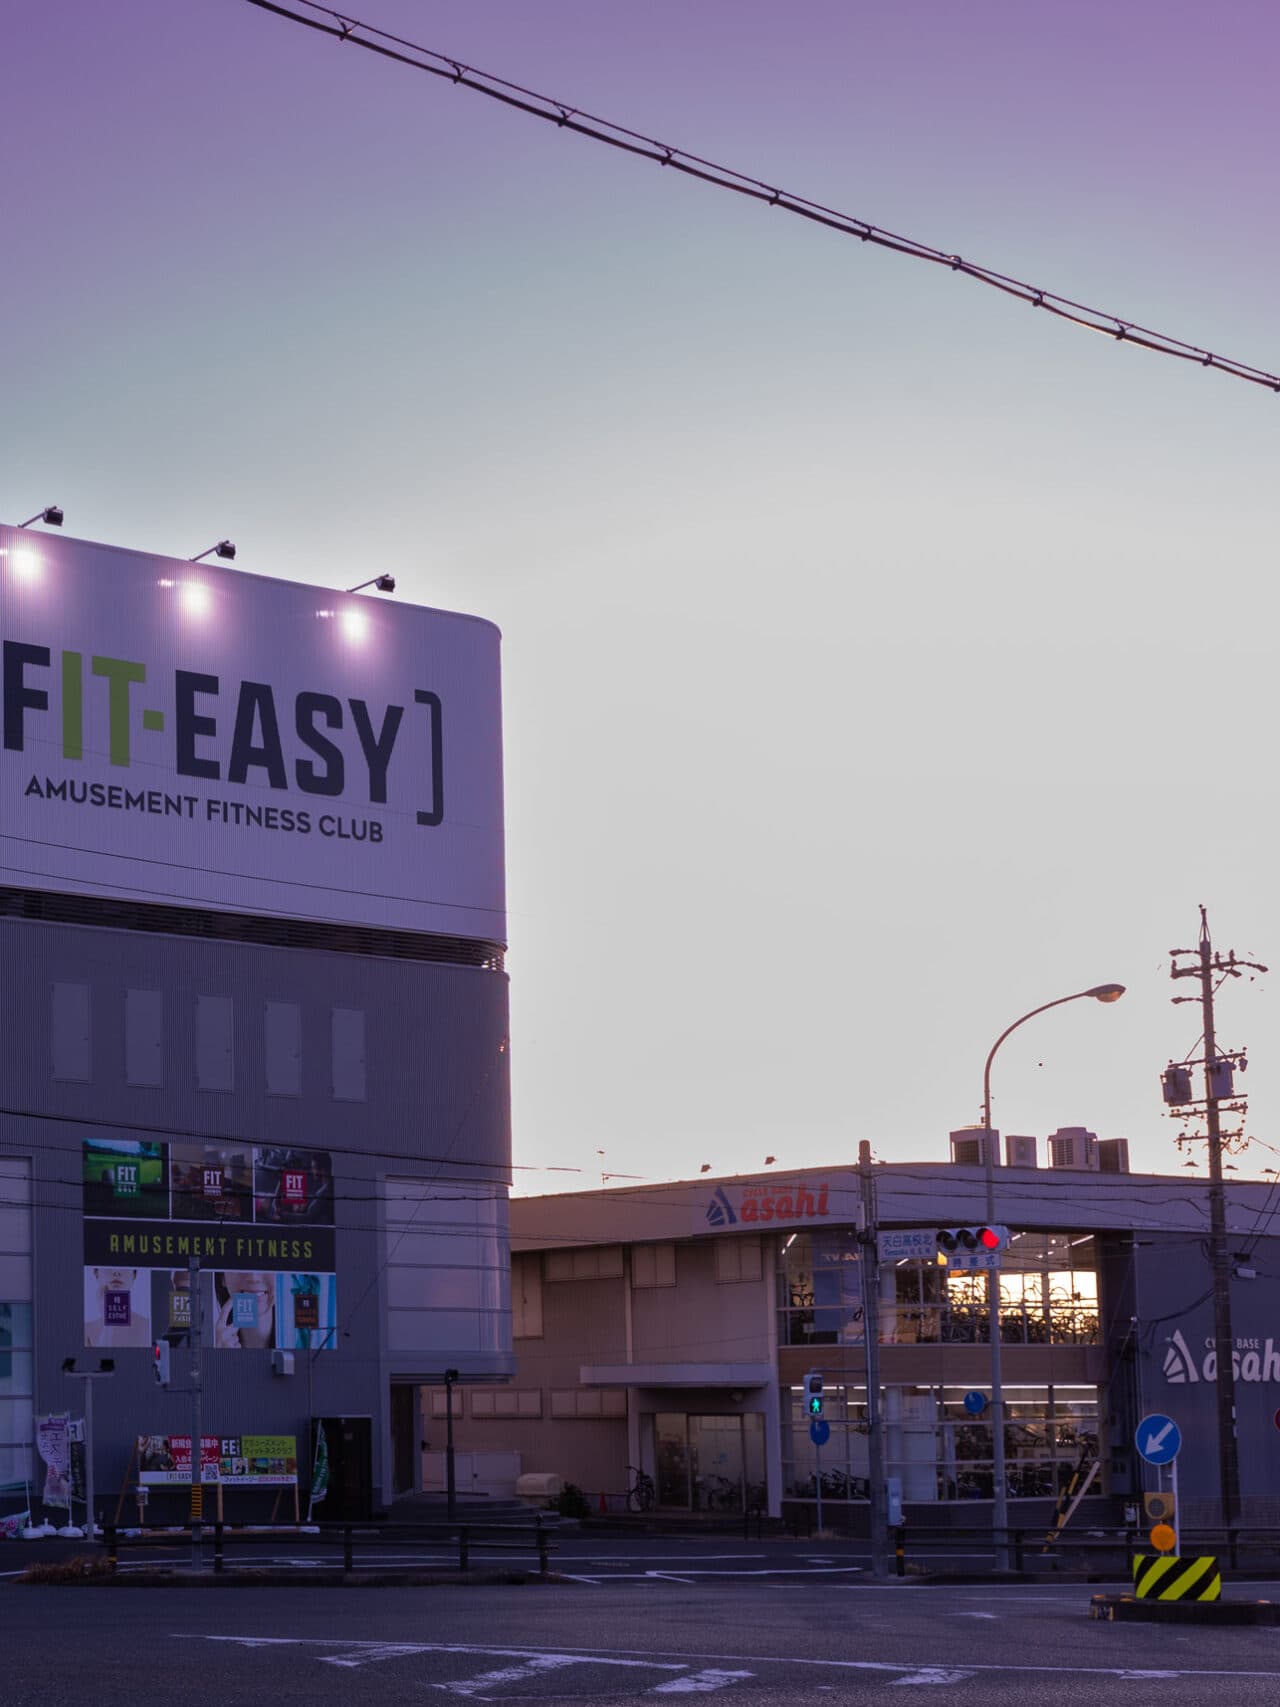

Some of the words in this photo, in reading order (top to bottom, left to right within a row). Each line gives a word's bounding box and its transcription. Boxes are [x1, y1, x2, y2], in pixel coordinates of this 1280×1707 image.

[24, 775, 199, 820] AMUSEMENT
[206, 799, 311, 834] FITNESS
[318, 815, 384, 843] CLUB
[117, 1166, 137, 1181] FIT
[203, 1170, 222, 1185] FIT
[286, 1174, 303, 1189] FIT
[740, 1183, 830, 1223] asahi
[109, 1234, 227, 1257] AMUSEMENT
[236, 1238, 313, 1259] FITNESS
[883, 1234, 932, 1248] 天白高校北
[237, 1299, 254, 1313] FIT
[1236, 1338, 1260, 1349] BASE
[172, 1438, 218, 1449] 新規会募集中
